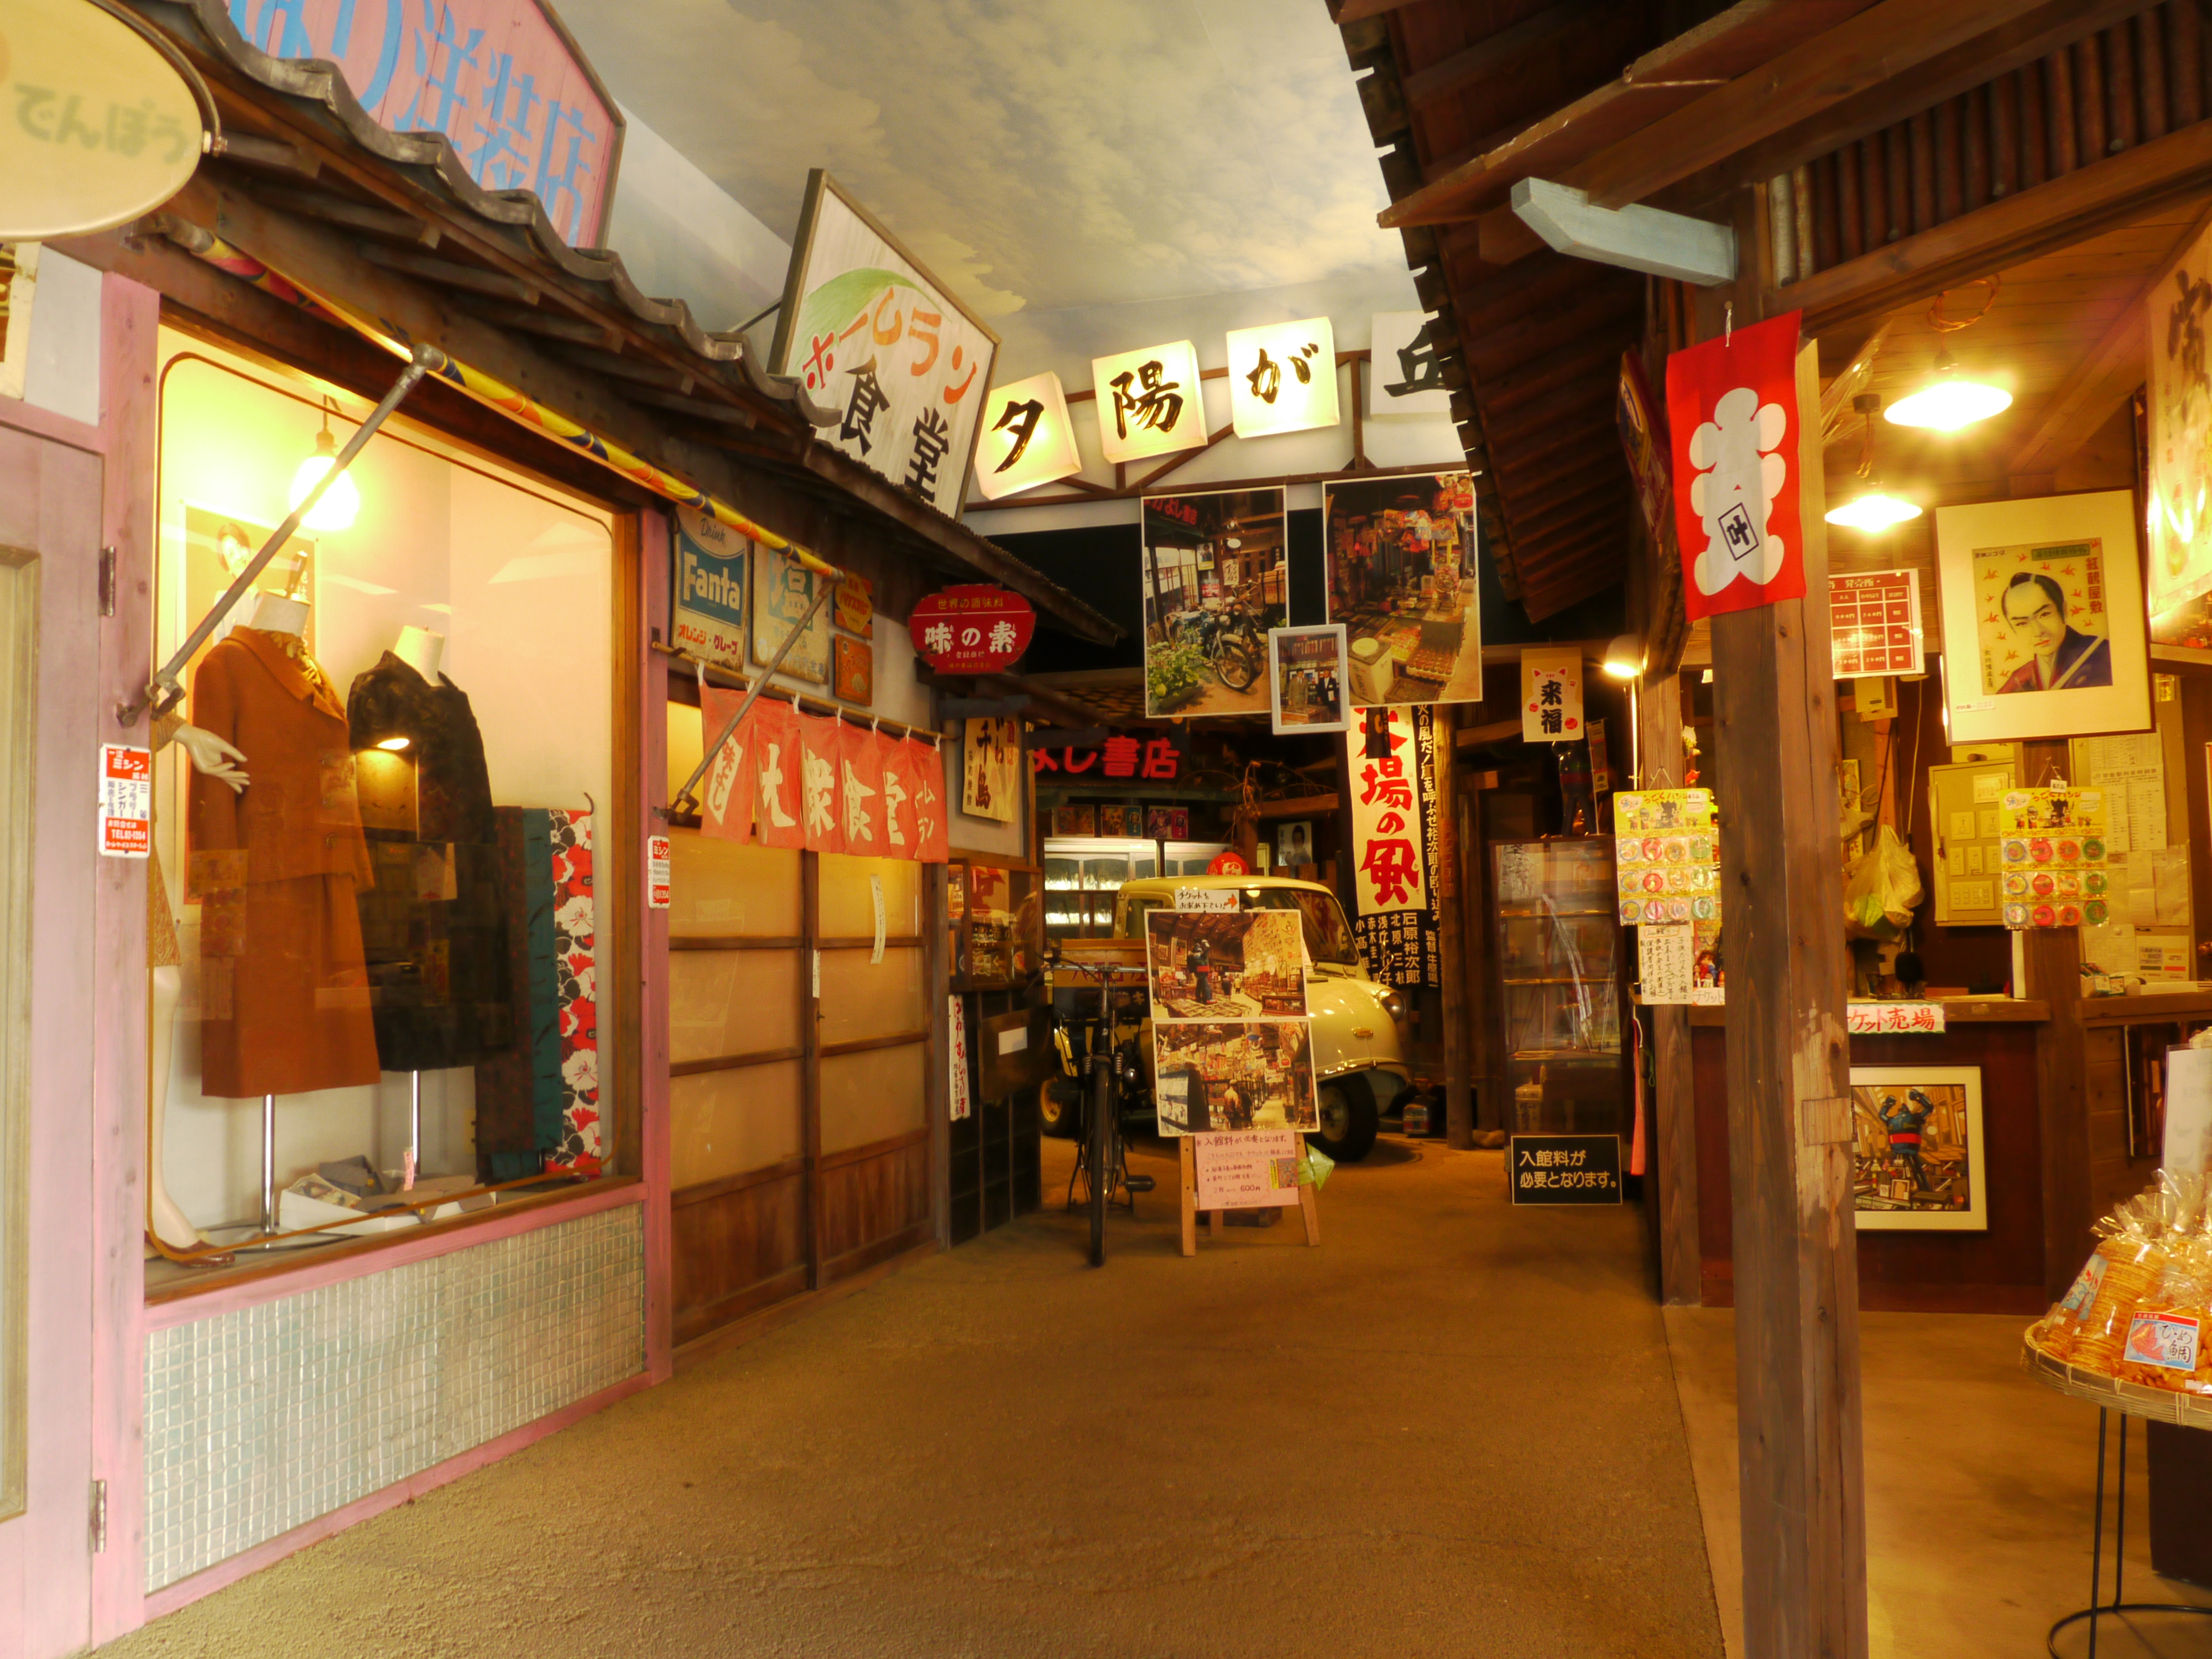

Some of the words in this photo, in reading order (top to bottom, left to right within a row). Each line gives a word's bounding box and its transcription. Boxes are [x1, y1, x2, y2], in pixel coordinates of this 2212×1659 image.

[14, 83, 188, 165] でんぽう
[840, 354, 950, 503] 食堂
[700, 518, 726, 547] Drink
[684, 551, 740, 611] Fanta
[938, 597, 1004, 610] 世界の調味料
[925, 620, 1017, 654] 味の素
[1541, 680, 1562, 734] 来福
[113, 758, 144, 771] ミシン
[1402, 912, 1420, 983] 石原裕次郎
[1848, 1007, 1935, 1031] ケット売場
[1520, 1150, 1587, 1167] 入館料が
[1520, 1171, 1616, 1188] 必要となります。
